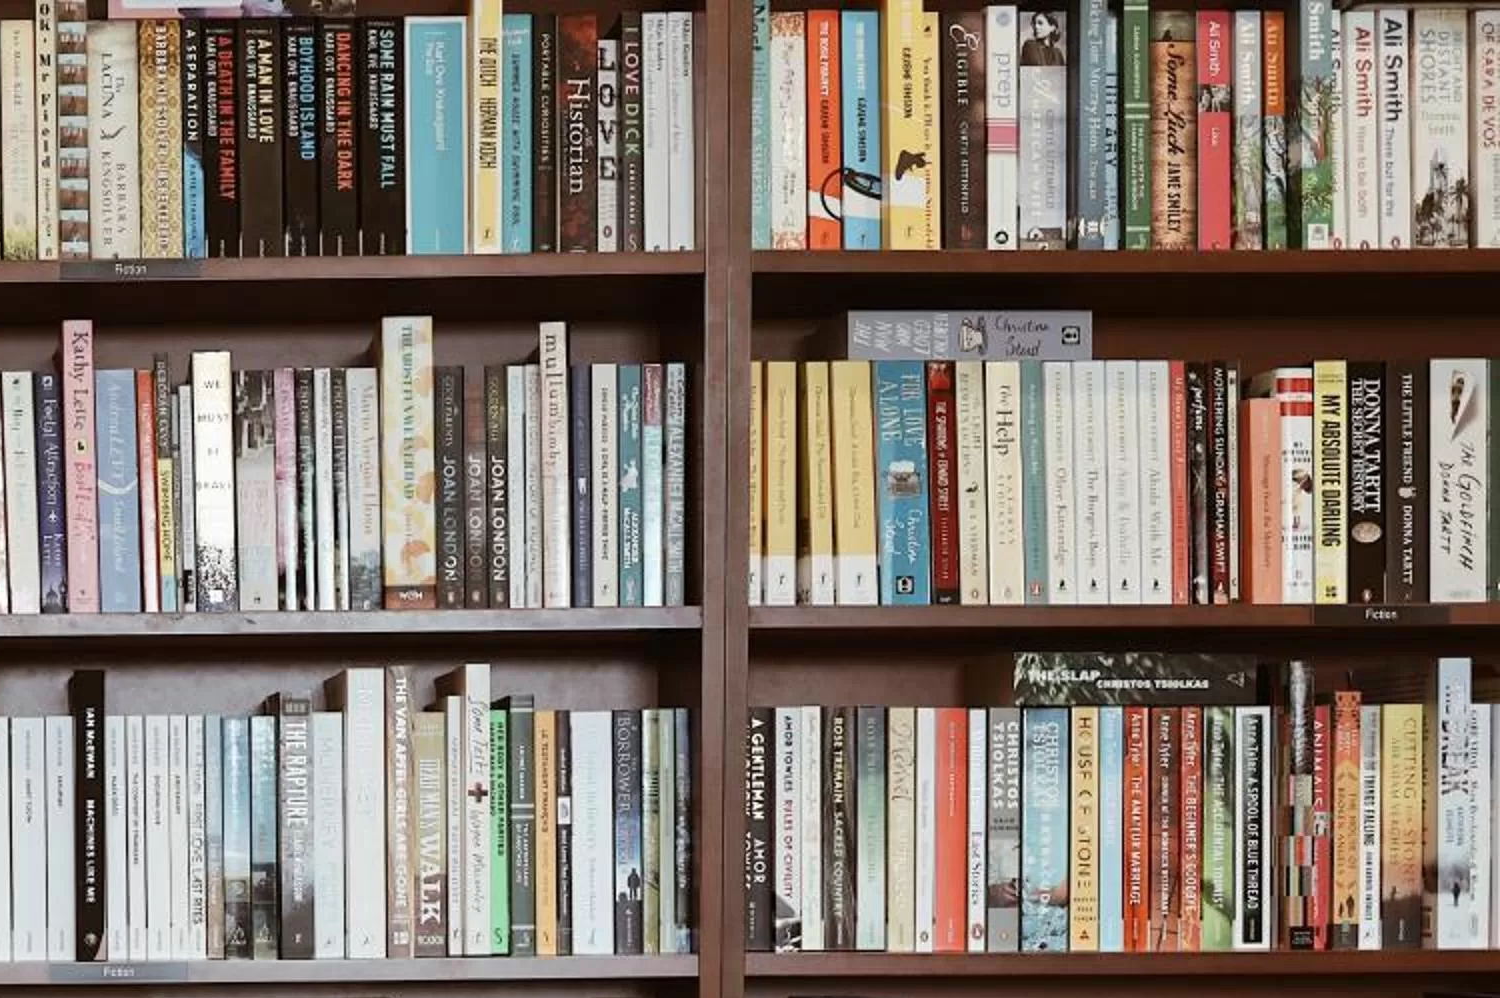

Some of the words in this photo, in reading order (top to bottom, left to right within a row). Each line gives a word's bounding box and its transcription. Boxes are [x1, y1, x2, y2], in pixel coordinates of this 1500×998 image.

[1356, 28, 1370, 56] Ali
[1384, 18, 1402, 50] Ali
[625, 42, 638, 95] LOVE
[996, 53, 1010, 109] prep
[1356, 59, 1372, 117] Smith
[1386, 55, 1403, 121] Smith
[569, 78, 590, 193] Historian
[625, 104, 639, 155] DICK
[73, 332, 88, 382] Kathy
[74, 387, 87, 431] Lette
[1321, 394, 1340, 416] MY
[1365, 377, 1382, 438] DONNA
[993, 411, 1014, 455] Help
[1322, 420, 1341, 492] ABSOLUTE
[493, 456, 504, 500] JOAN
[1366, 444, 1381, 512] TARTT
[494, 504, 506, 582] LONDON
[1322, 497, 1341, 547] DARLING
[1366, 609, 1396, 619] Fiction
[1028, 669, 1057, 682] THE
[1061, 670, 1099, 681] SLAP
[751, 718, 763, 728] A
[753, 733, 764, 819] GENTLEMAN
[992, 722, 1002, 808] TSIOLKAS
[1007, 722, 1019, 810] CHRISTOS
